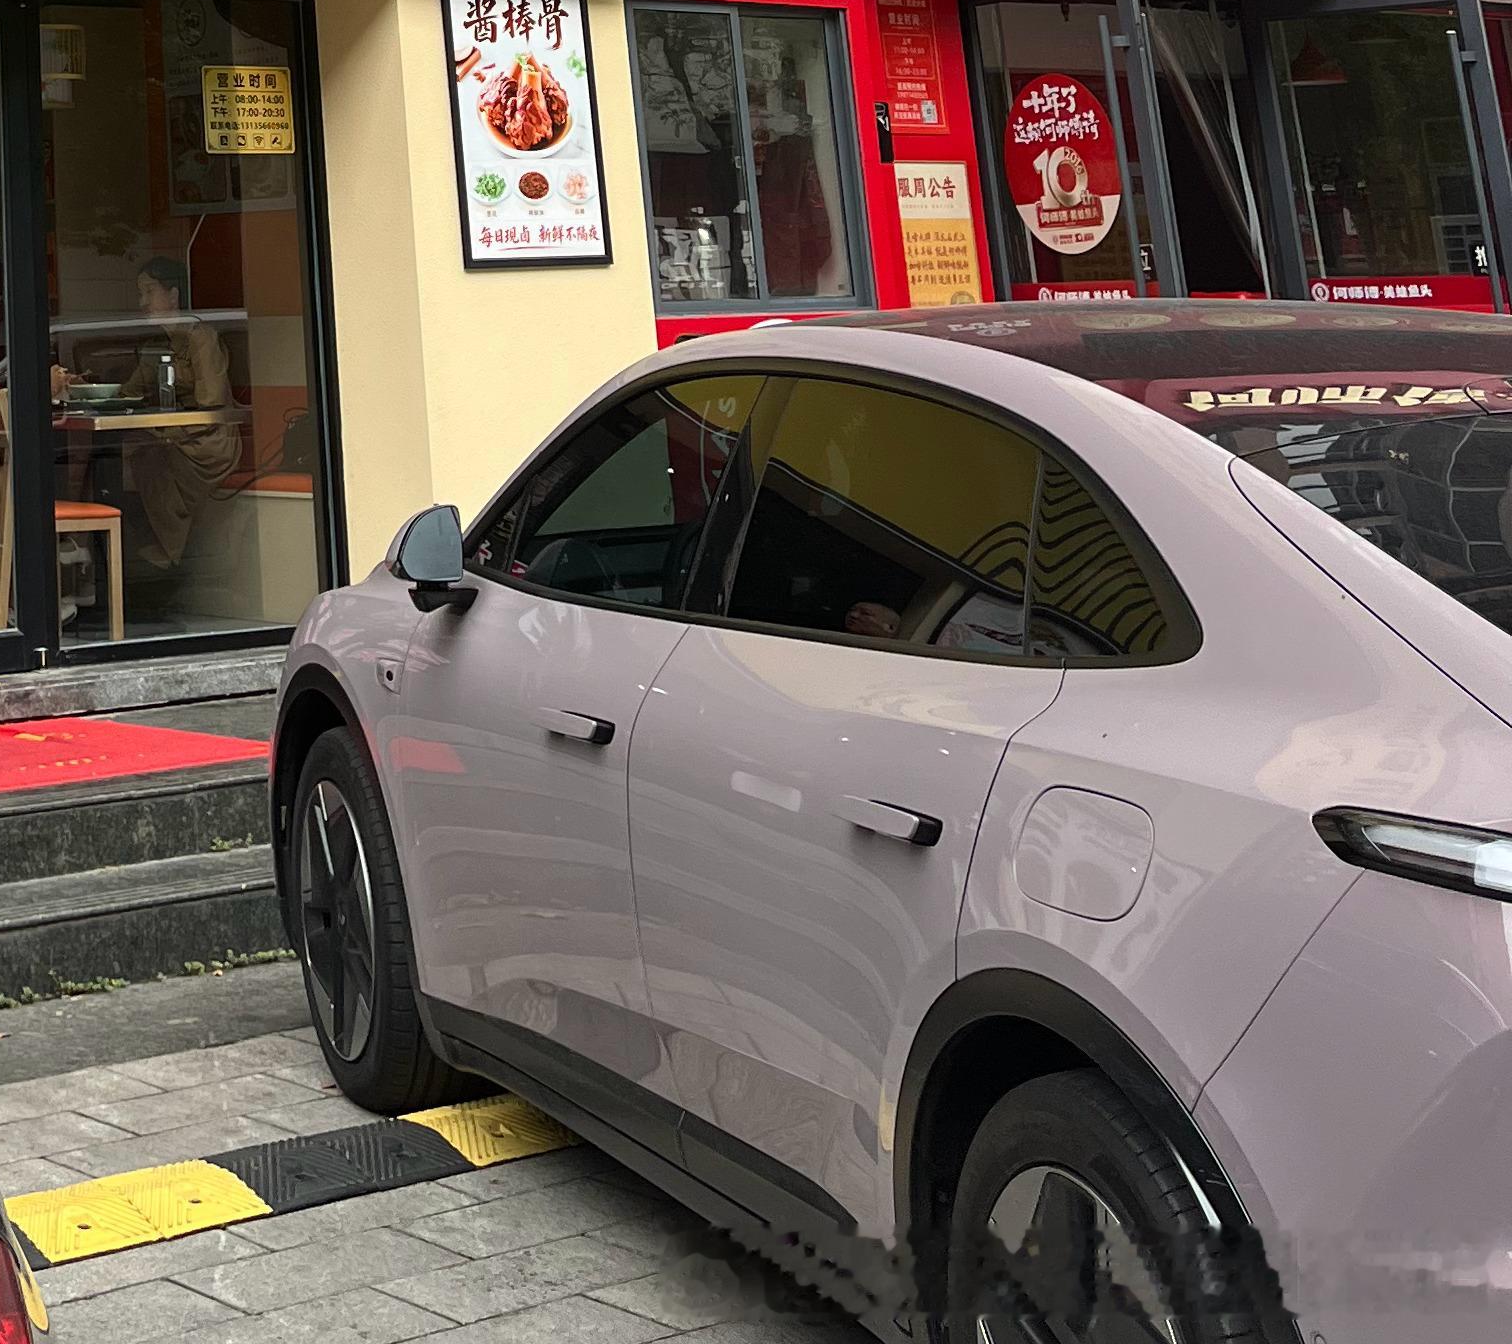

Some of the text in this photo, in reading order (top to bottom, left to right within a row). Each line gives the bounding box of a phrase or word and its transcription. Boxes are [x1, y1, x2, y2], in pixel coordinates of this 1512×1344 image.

[216, 72, 278, 89] 营业时间
[235, 94, 285, 105] 08:00-14:00
[1022, 83, 1078, 118] 十年了
[236, 107, 285, 118] 17:00-20:30
